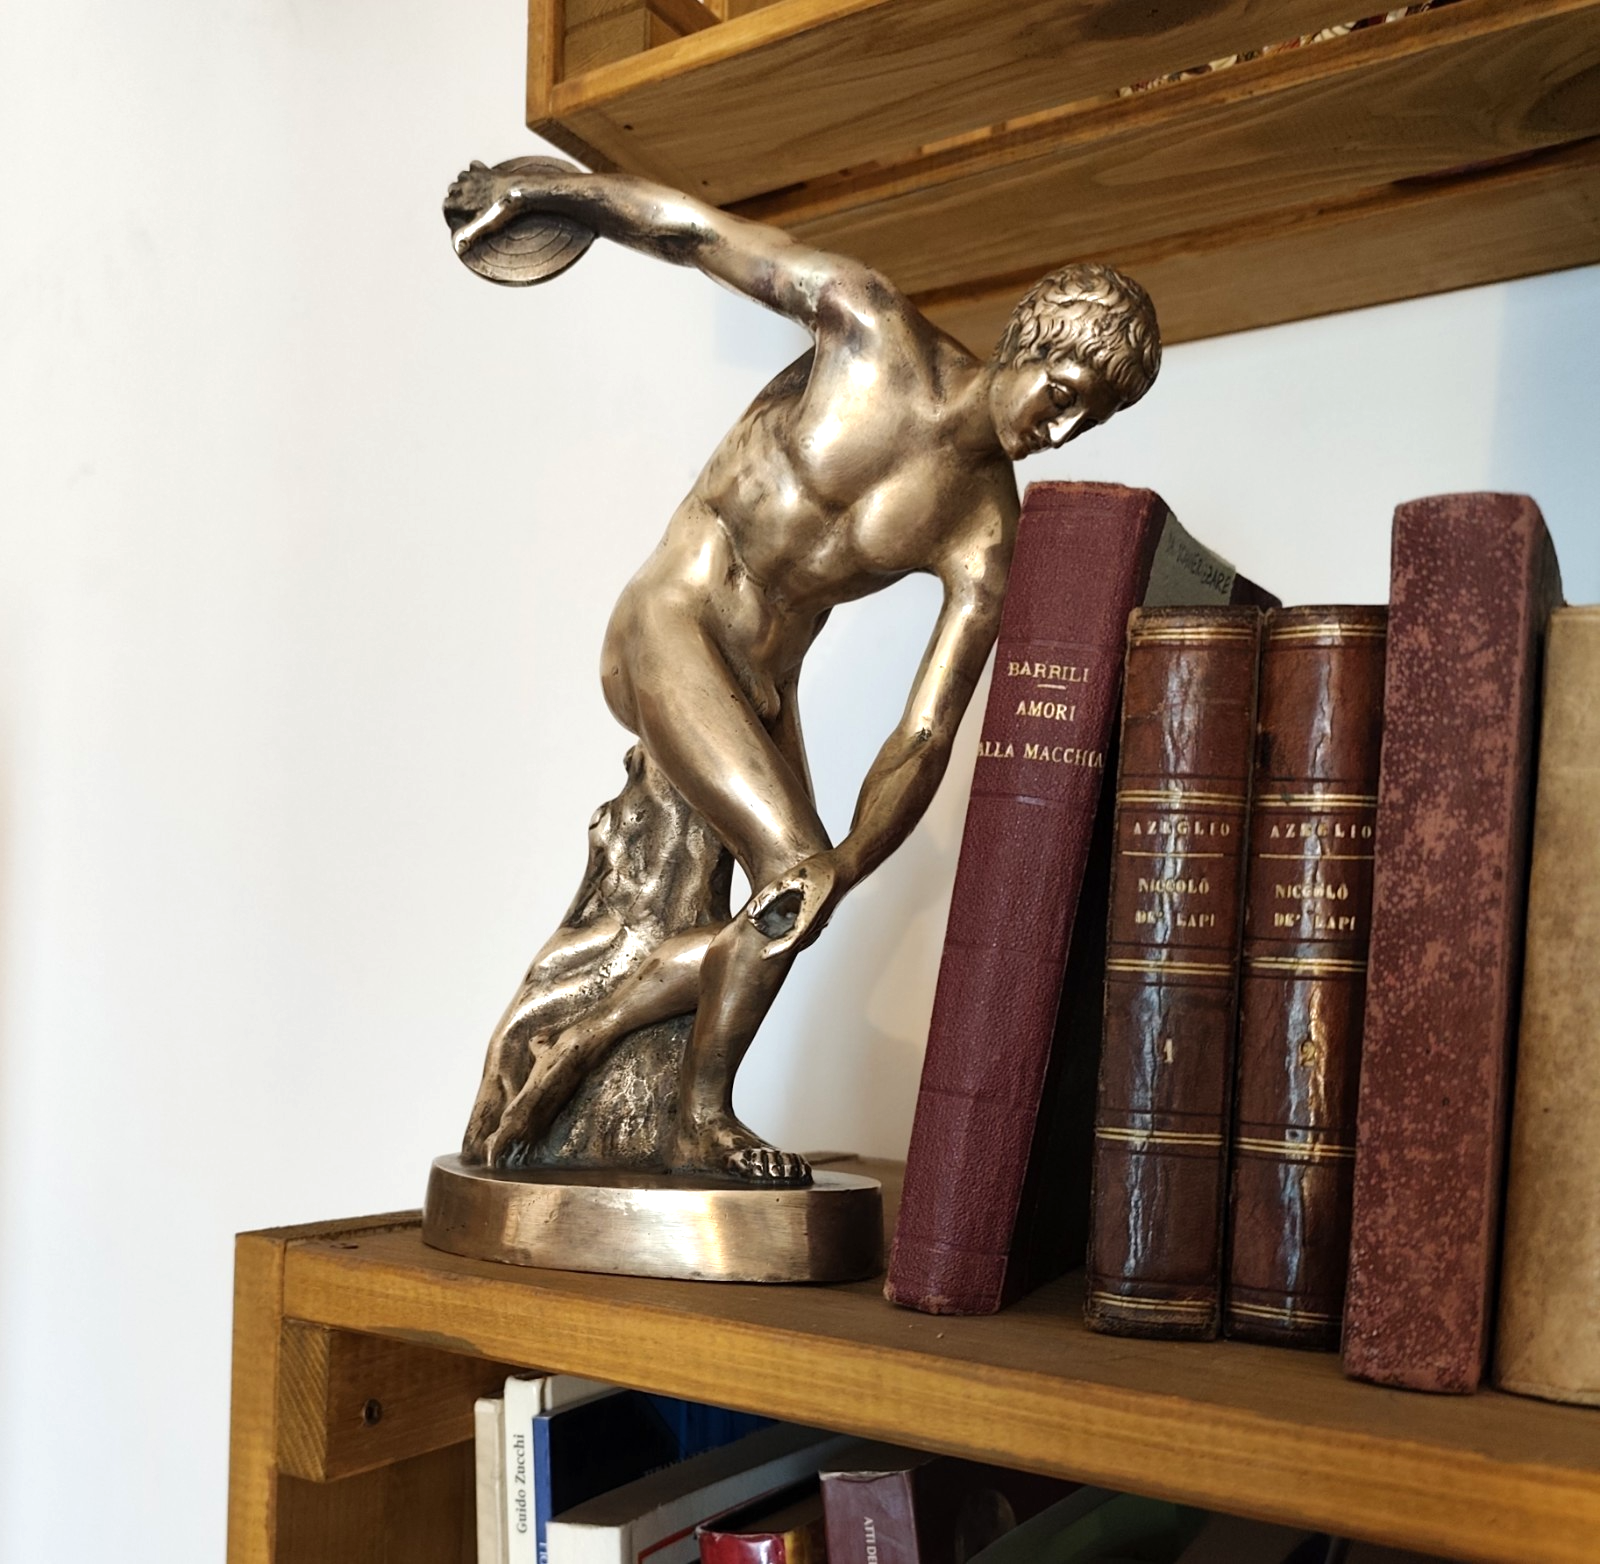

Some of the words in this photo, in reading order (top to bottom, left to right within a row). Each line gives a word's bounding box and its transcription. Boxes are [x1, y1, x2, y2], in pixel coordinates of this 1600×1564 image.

[1007, 661, 1089, 683] BARRILI
[1016, 700, 1076, 722] AMORI
[1023, 742, 1104, 768] MACCHIA
[1133, 820, 1231, 837] AZEGLIO
[1270, 822, 1373, 839] AZEGLIO
[1176, 912, 1216, 928] LAPI
[1313, 915, 1357, 932] LAPI
[1163, 1038, 1175, 1064] 1
[513, 1434, 526, 1485] Zucchi
[516, 1489, 528, 1534] Guido
[863, 1516, 876, 1543] ATTI
